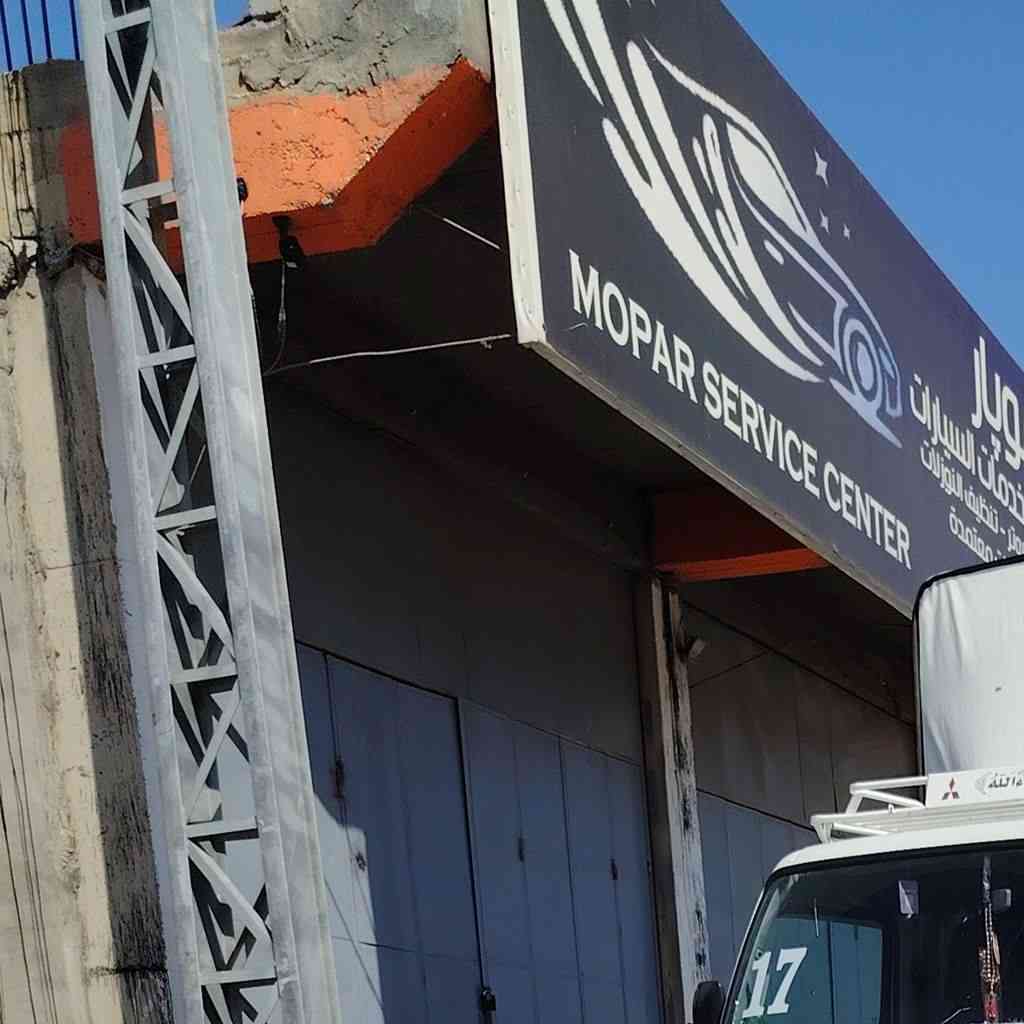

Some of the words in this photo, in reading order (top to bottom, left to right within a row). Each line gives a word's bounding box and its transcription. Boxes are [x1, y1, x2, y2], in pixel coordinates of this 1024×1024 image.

[568, 249, 698, 403] MOPAR
[701, 361, 820, 499] SERVICE
[823, 461, 912, 569] CENTER
[910, 373, 976, 475] السيارات
[742, 947, 807, 1018] 17
